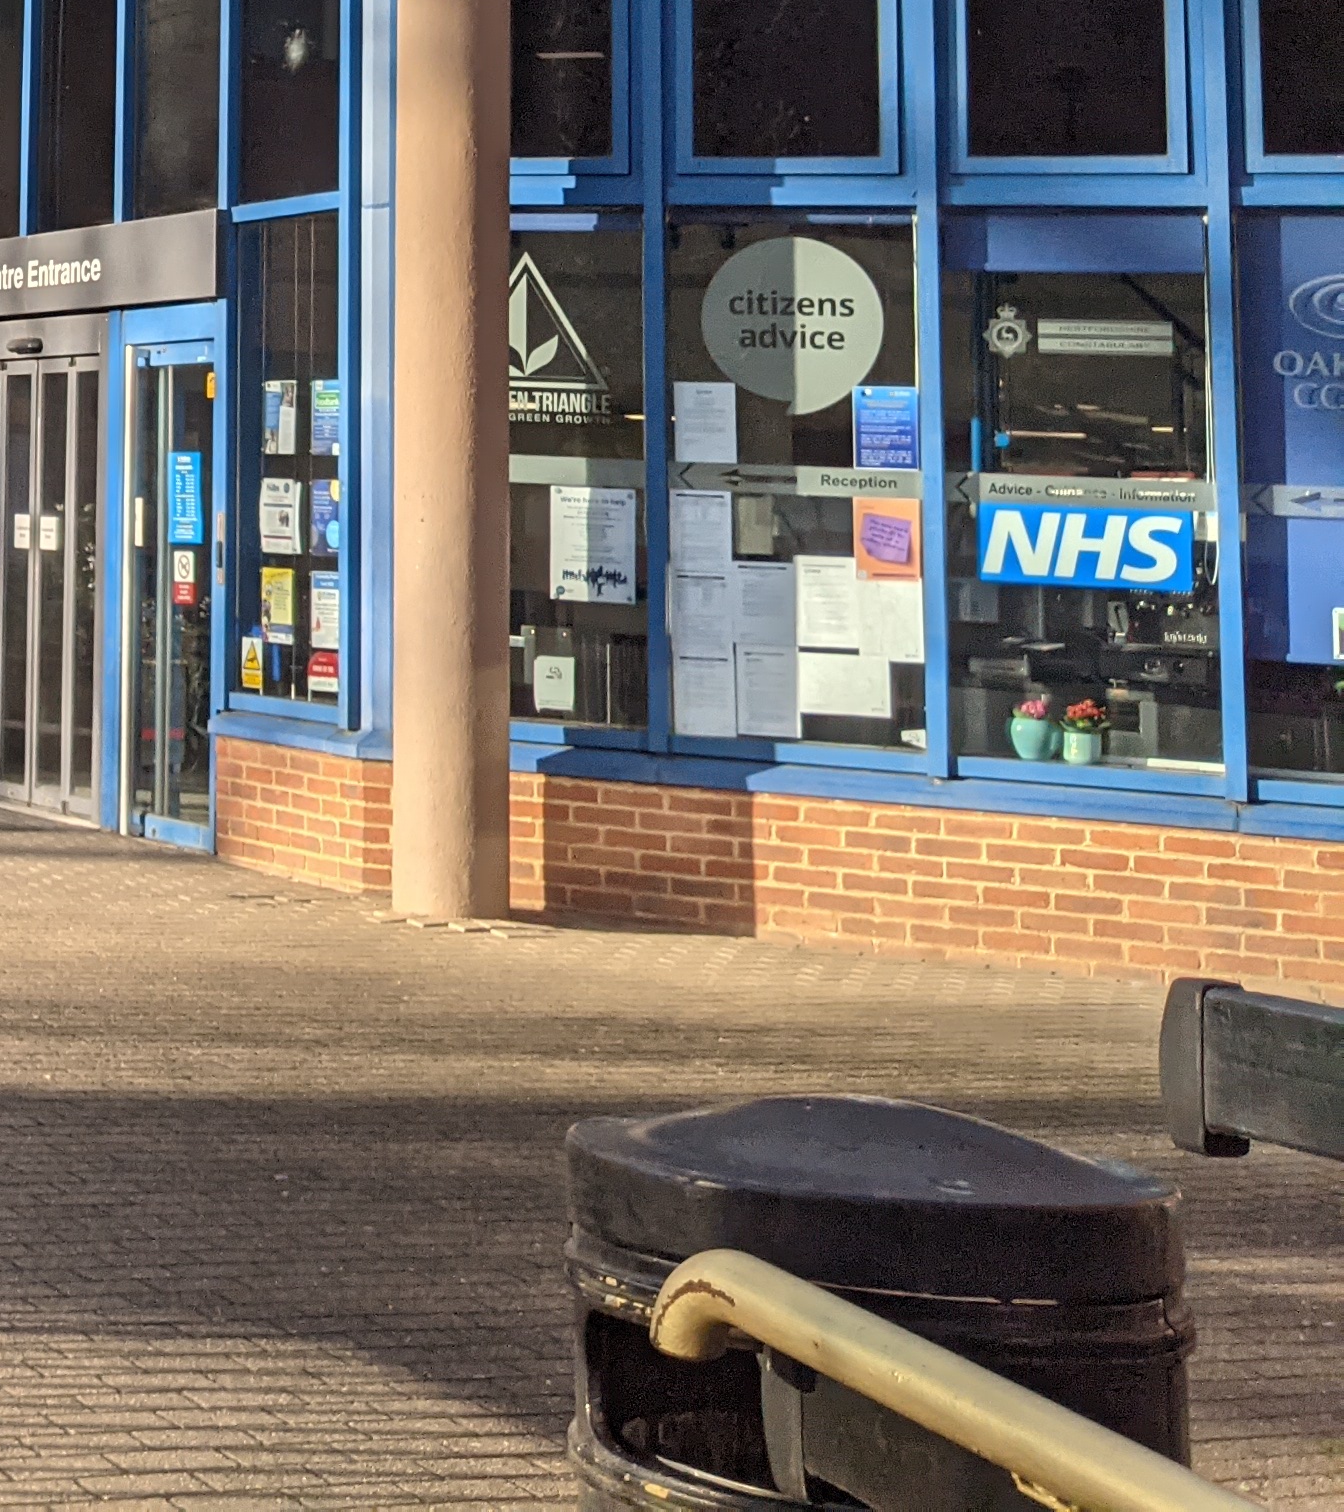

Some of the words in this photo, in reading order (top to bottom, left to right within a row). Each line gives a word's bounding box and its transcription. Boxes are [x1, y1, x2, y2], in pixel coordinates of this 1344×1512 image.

[27, 258, 102, 288] Entrance
[728, 289, 855, 317] citizens
[738, 322, 845, 351] advice
[531, 391, 612, 414] TRIANGLE
[508, 413, 551, 423] GREEN
[820, 474, 898, 489] Reception
[988, 483, 1033, 496] Advice
[981, 509, 1183, 583] NHS
